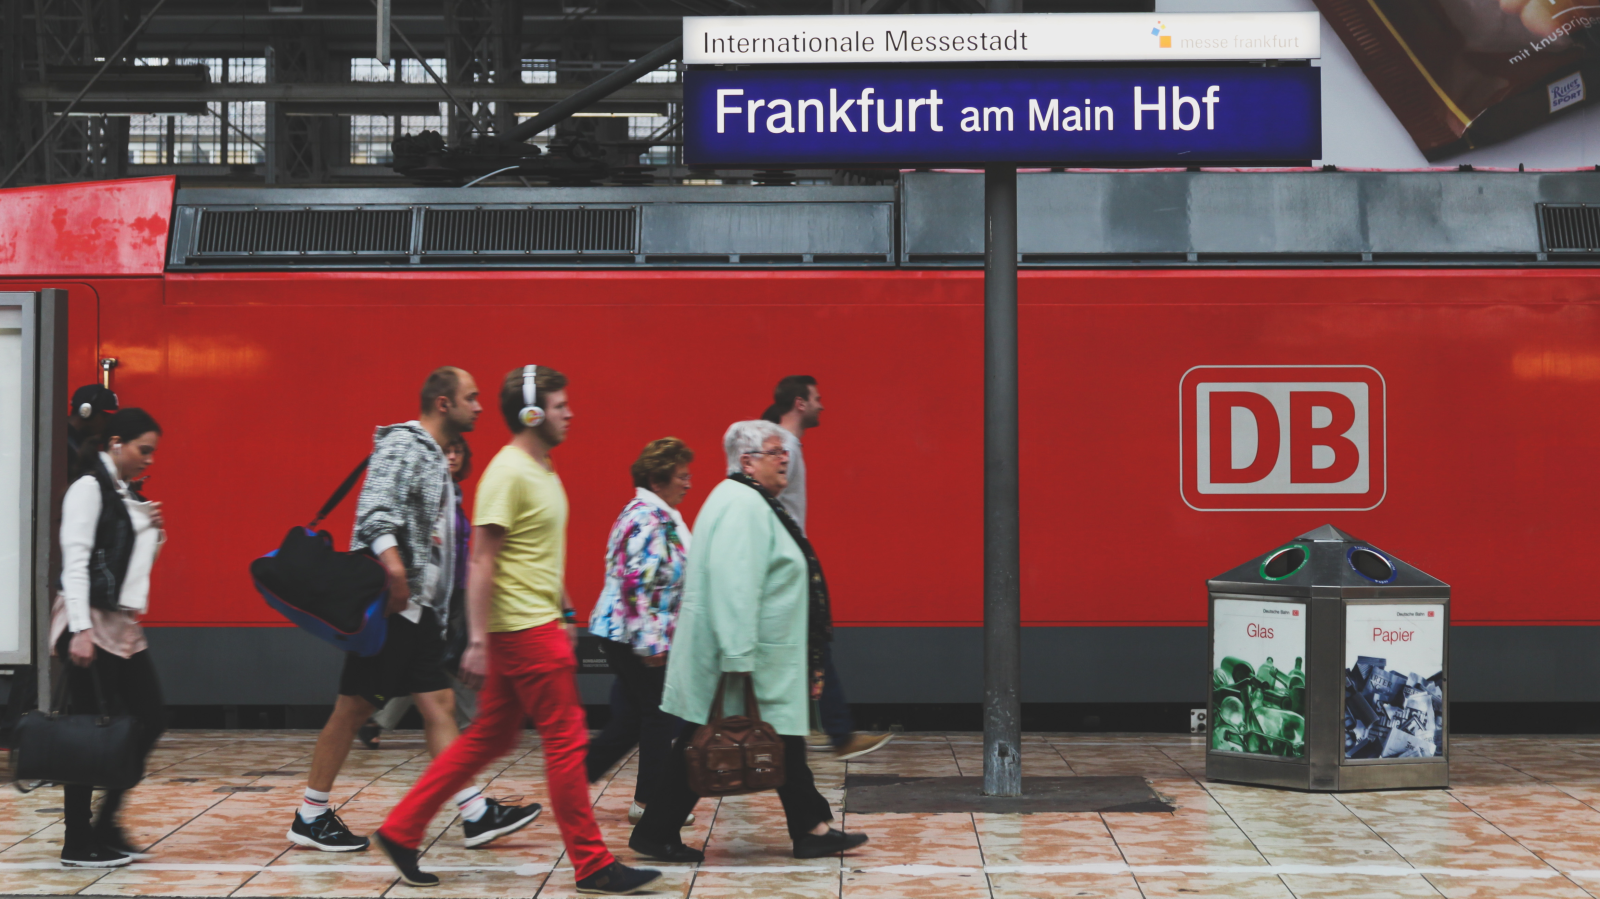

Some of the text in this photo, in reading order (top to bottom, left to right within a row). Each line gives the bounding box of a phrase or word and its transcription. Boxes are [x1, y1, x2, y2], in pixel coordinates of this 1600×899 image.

[704, 30, 1028, 54] Internationale Messestadt
[1180, 34, 1300, 49] messe frankfurt
[1509, 48, 1531, 65] mit
[1551, 79, 1580, 99] Ritter
[1552, 90, 1582, 107] SPORT
[716, 85, 1220, 134] Frankfurt am Main Hbf
[1209, 391, 1360, 484] DB
[1247, 623, 1275, 639] Glas
[1372, 627, 1415, 645] Papier
